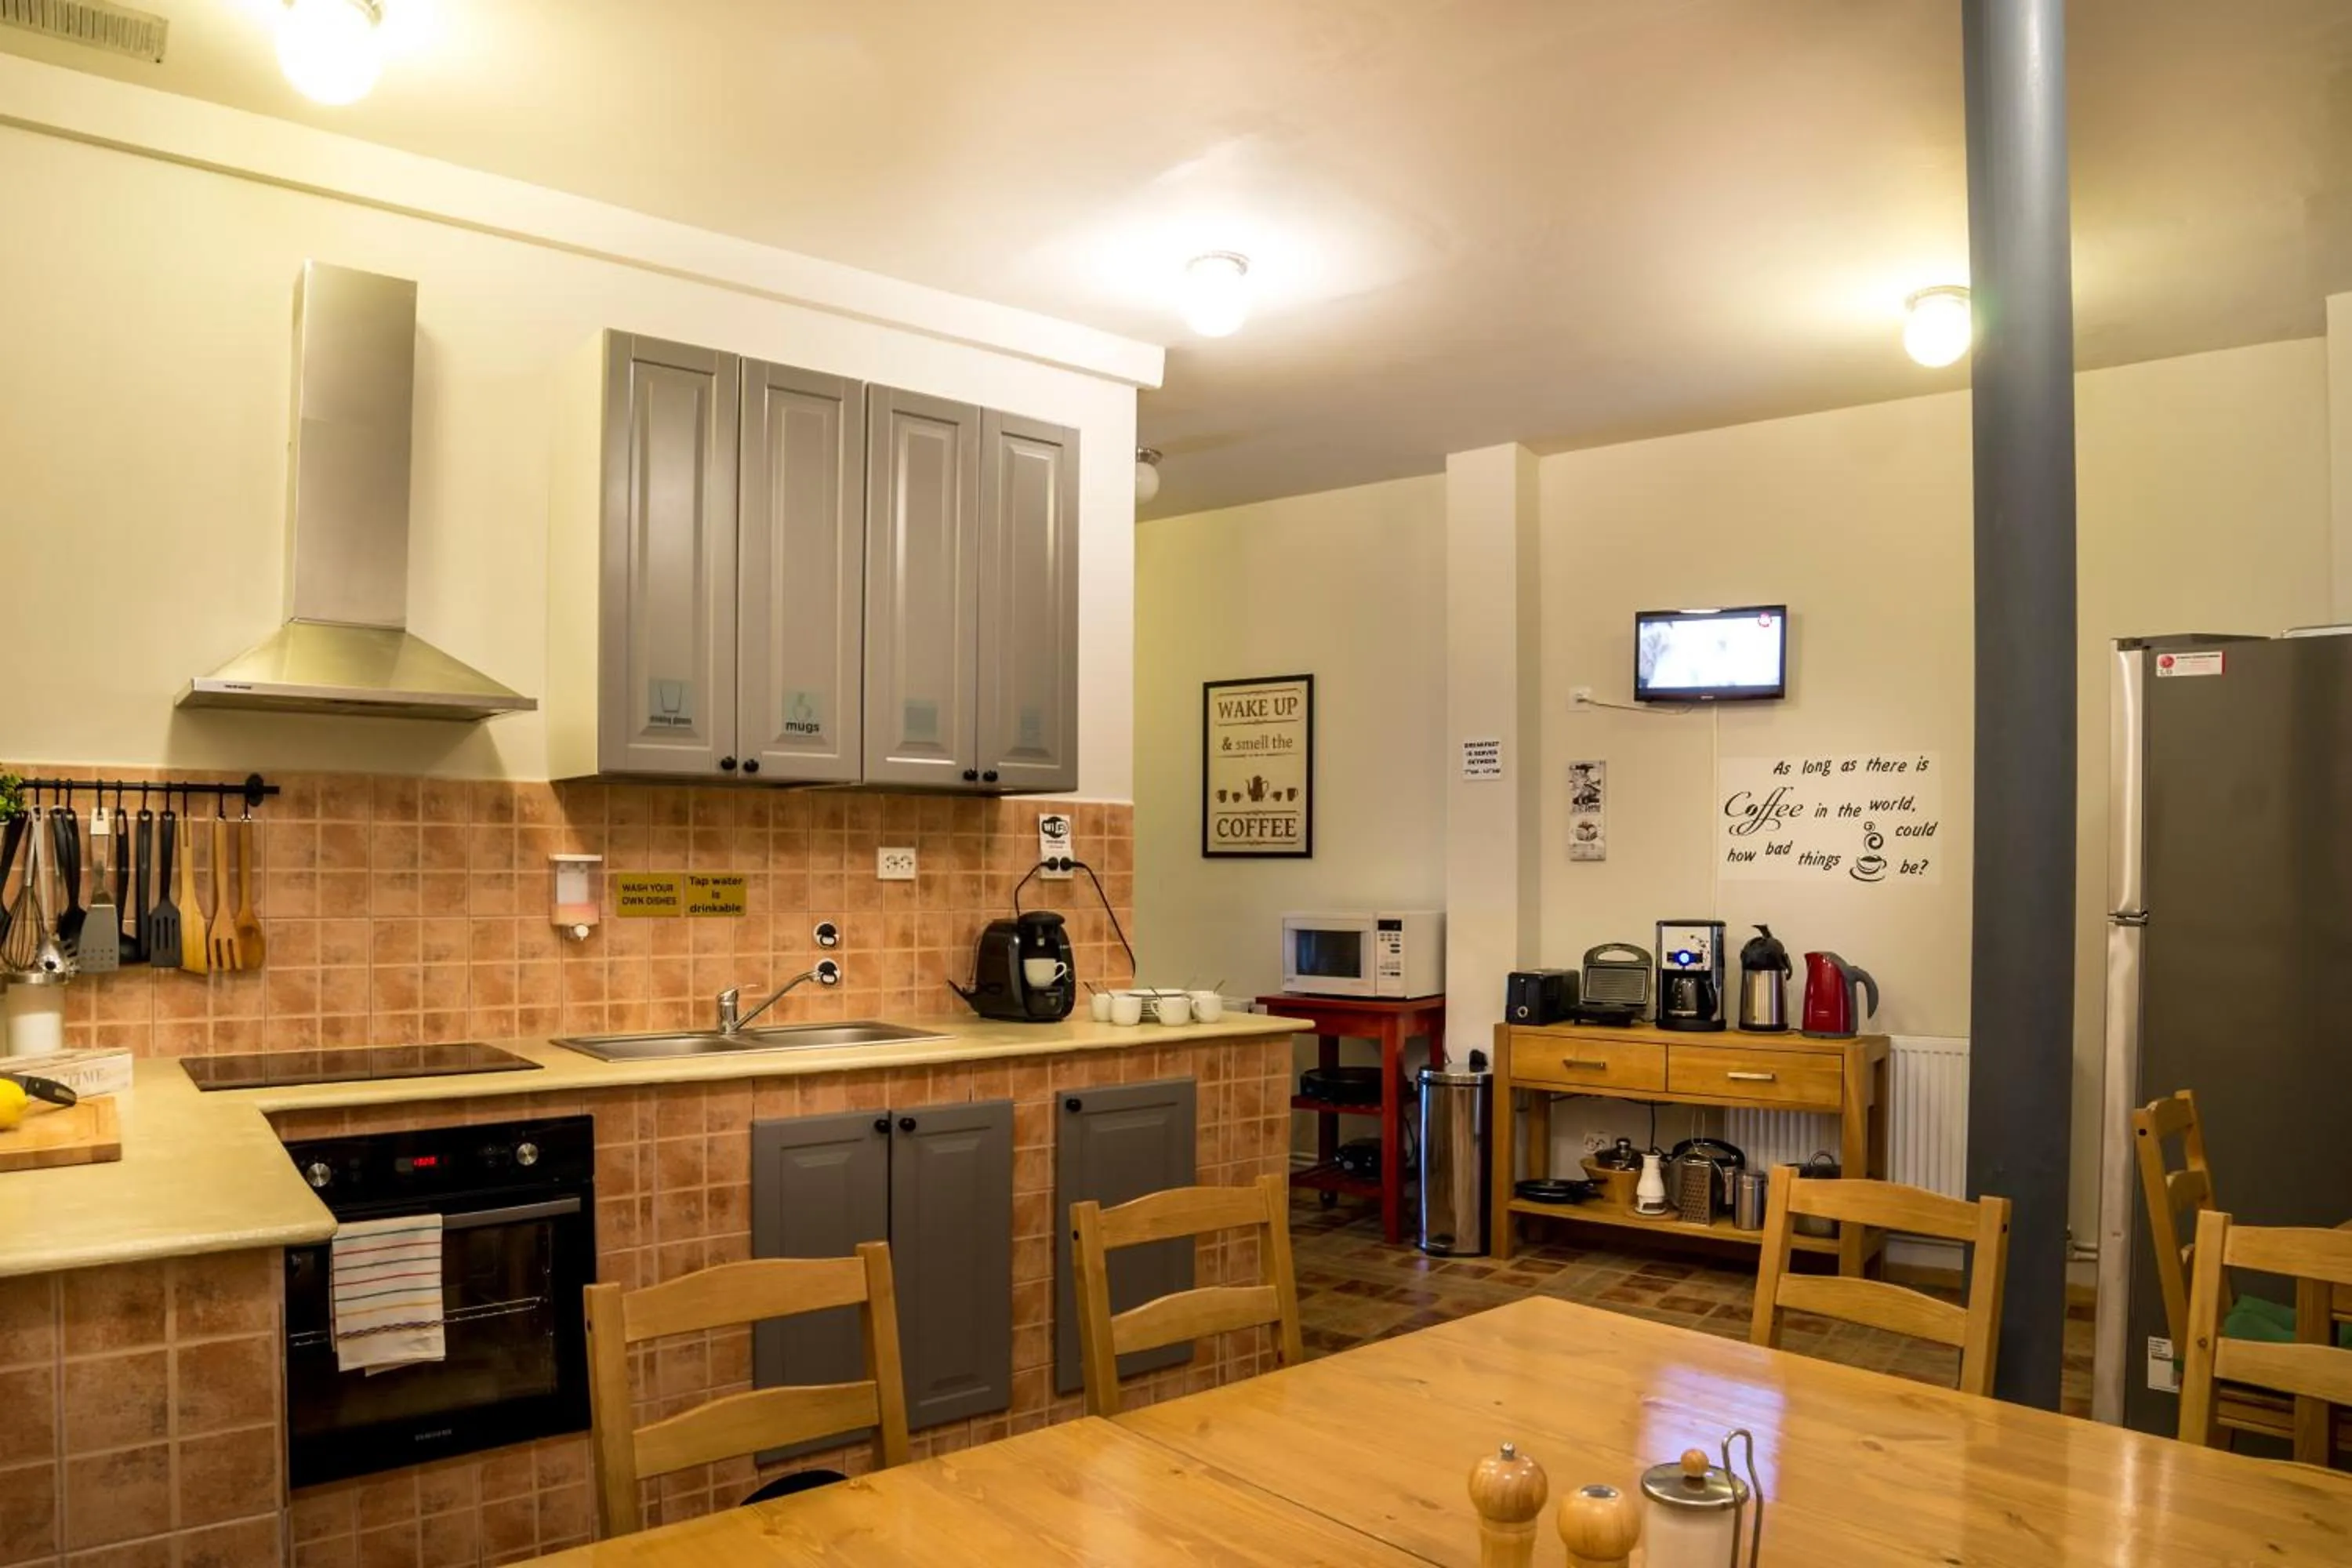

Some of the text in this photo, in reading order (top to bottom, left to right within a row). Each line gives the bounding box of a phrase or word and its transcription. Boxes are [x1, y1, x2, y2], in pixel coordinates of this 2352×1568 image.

[1218, 696, 1298, 719] WAKE UP
[786, 721, 819, 734] mugs
[1221, 733, 1293, 751] & smell the
[1773, 755, 1929, 776] As long as there is
[1725, 786, 1804, 836] Coffee
[1814, 802, 1828, 818] in
[1838, 802, 1862, 818] the
[1216, 818, 1298, 838] COFFEE
[1727, 822, 1939, 871] how bad things could
[1900, 858, 1929, 876] be?
[622, 884, 673, 892] WASH YOUR
[689, 876, 743, 887] Tap water
[622, 896, 677, 906] OWN DISHES
[689, 902, 742, 913] drinkable
